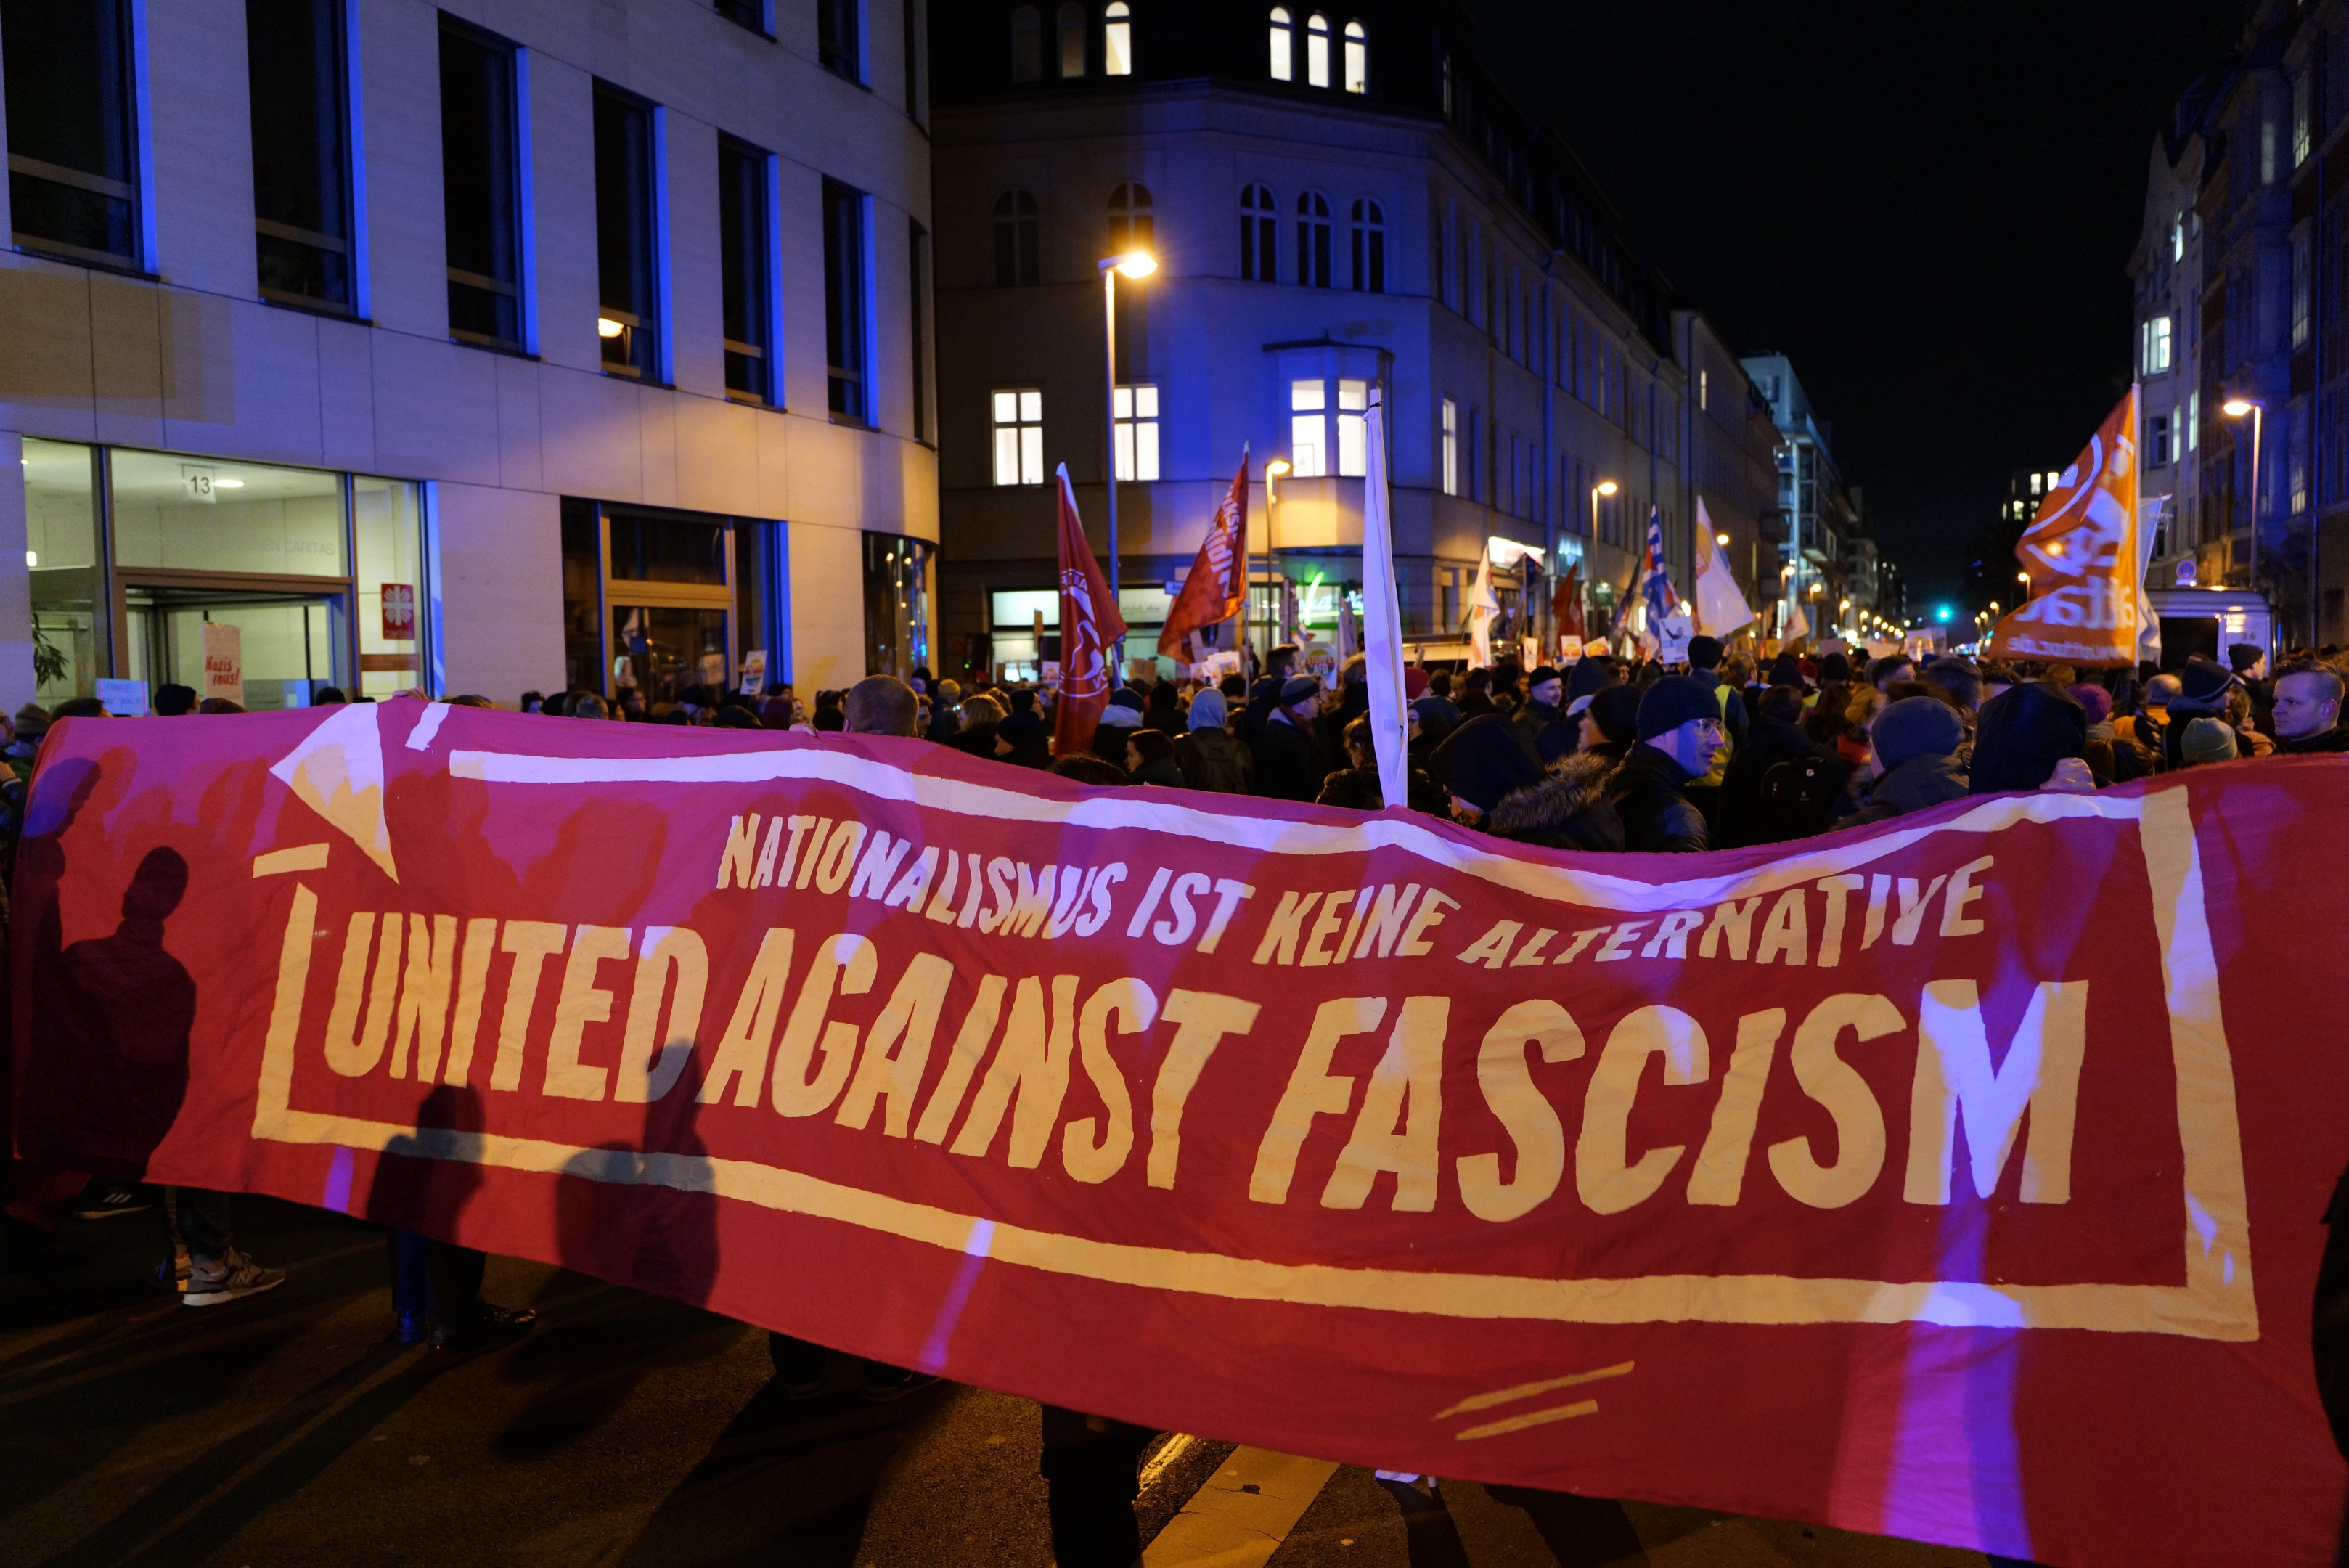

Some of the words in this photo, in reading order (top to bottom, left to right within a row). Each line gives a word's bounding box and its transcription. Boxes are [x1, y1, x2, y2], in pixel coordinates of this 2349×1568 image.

[190, 475, 210, 494] 13
[283, 540, 335, 556] CARITAS
[205, 656, 232, 672] Nazis
[213, 667, 240, 685] raus!
[716, 813, 1128, 939] NATIONALISMUS
[1127, 867, 1256, 953] IST
[1252, 884, 1461, 967] KEINE
[1456, 854, 1995, 968] ALTERNATIVE
[324, 912, 708, 1104] UNITED
[697, 928, 1261, 1191] AGAINST
[1249, 979, 2089, 1222] FASCISM
